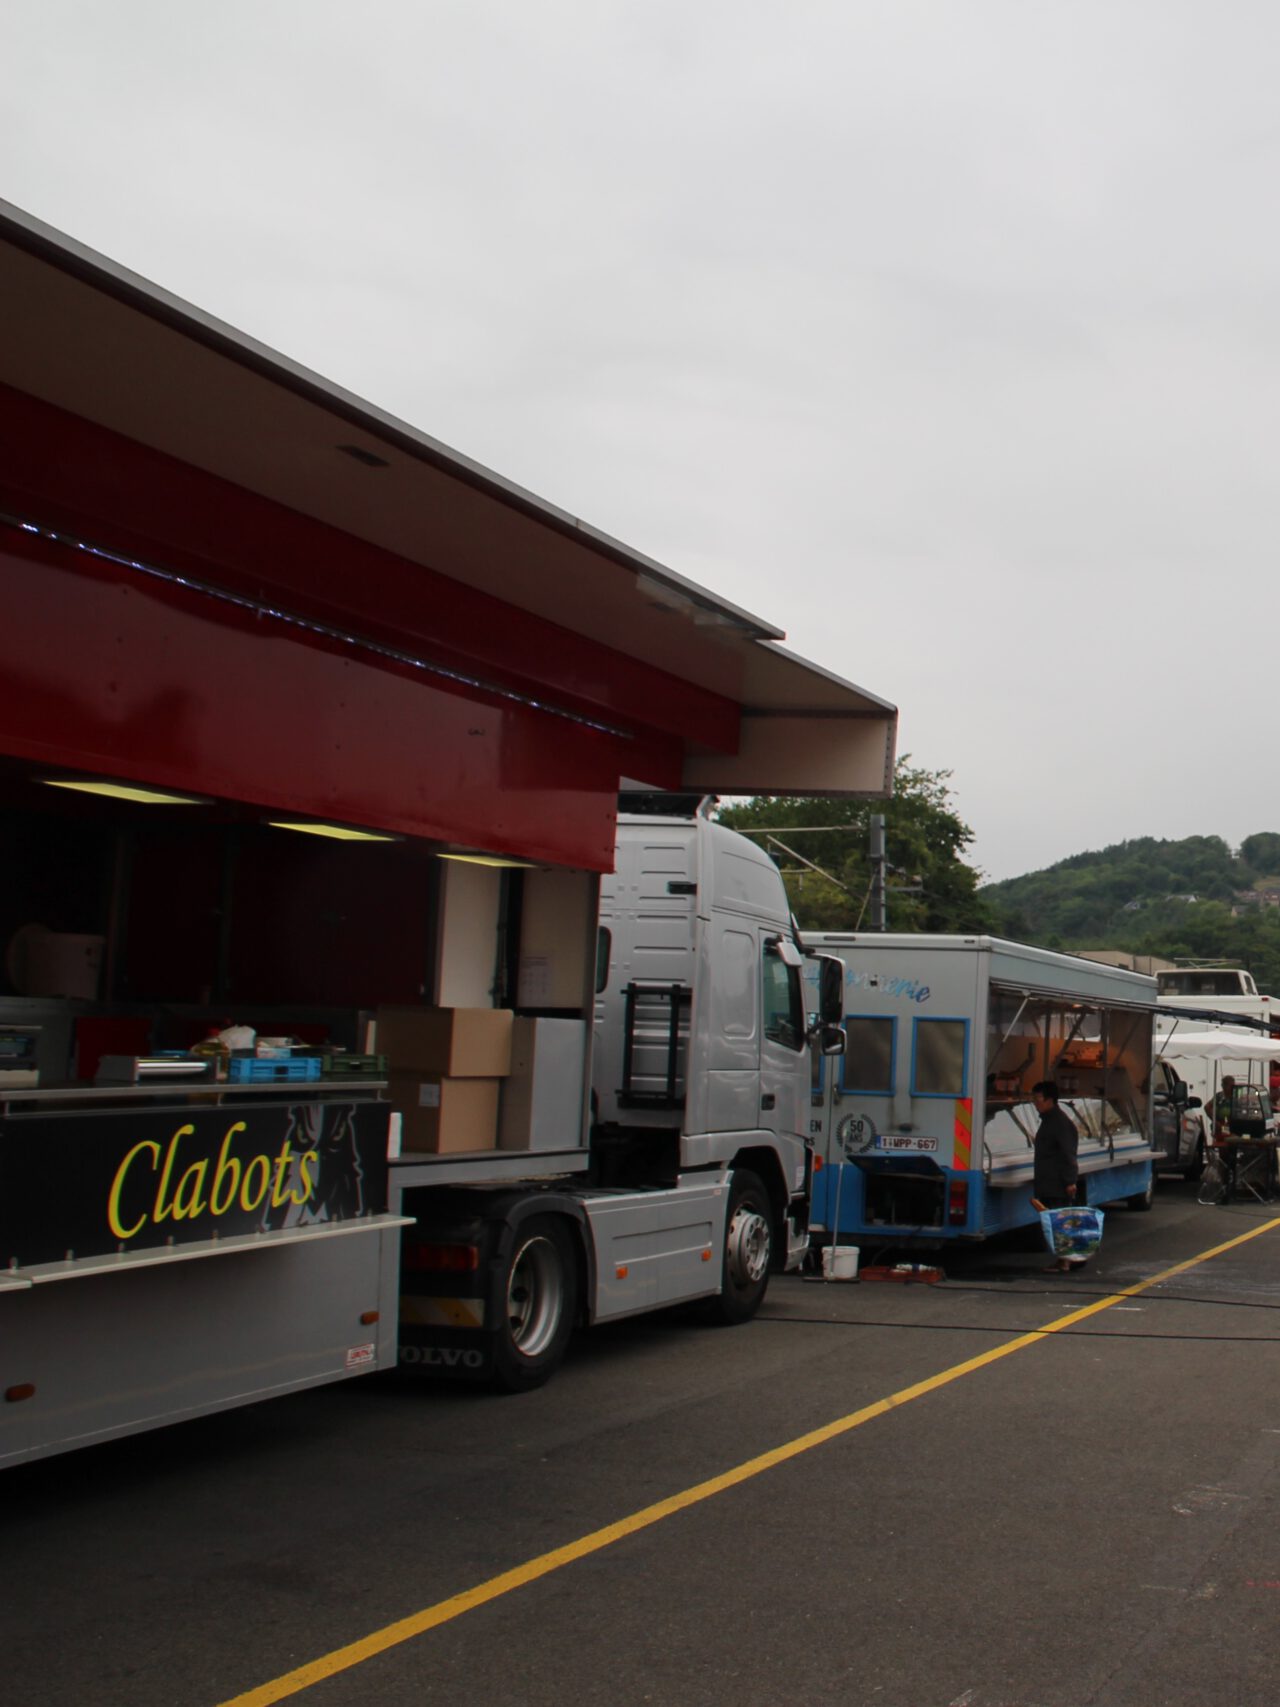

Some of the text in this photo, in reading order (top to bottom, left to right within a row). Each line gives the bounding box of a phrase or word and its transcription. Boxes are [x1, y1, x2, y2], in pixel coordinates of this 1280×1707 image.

[850, 1120, 864, 1132] 50
[107, 1120, 319, 1240] Clabots
[399, 1345, 484, 1368] OLVO
